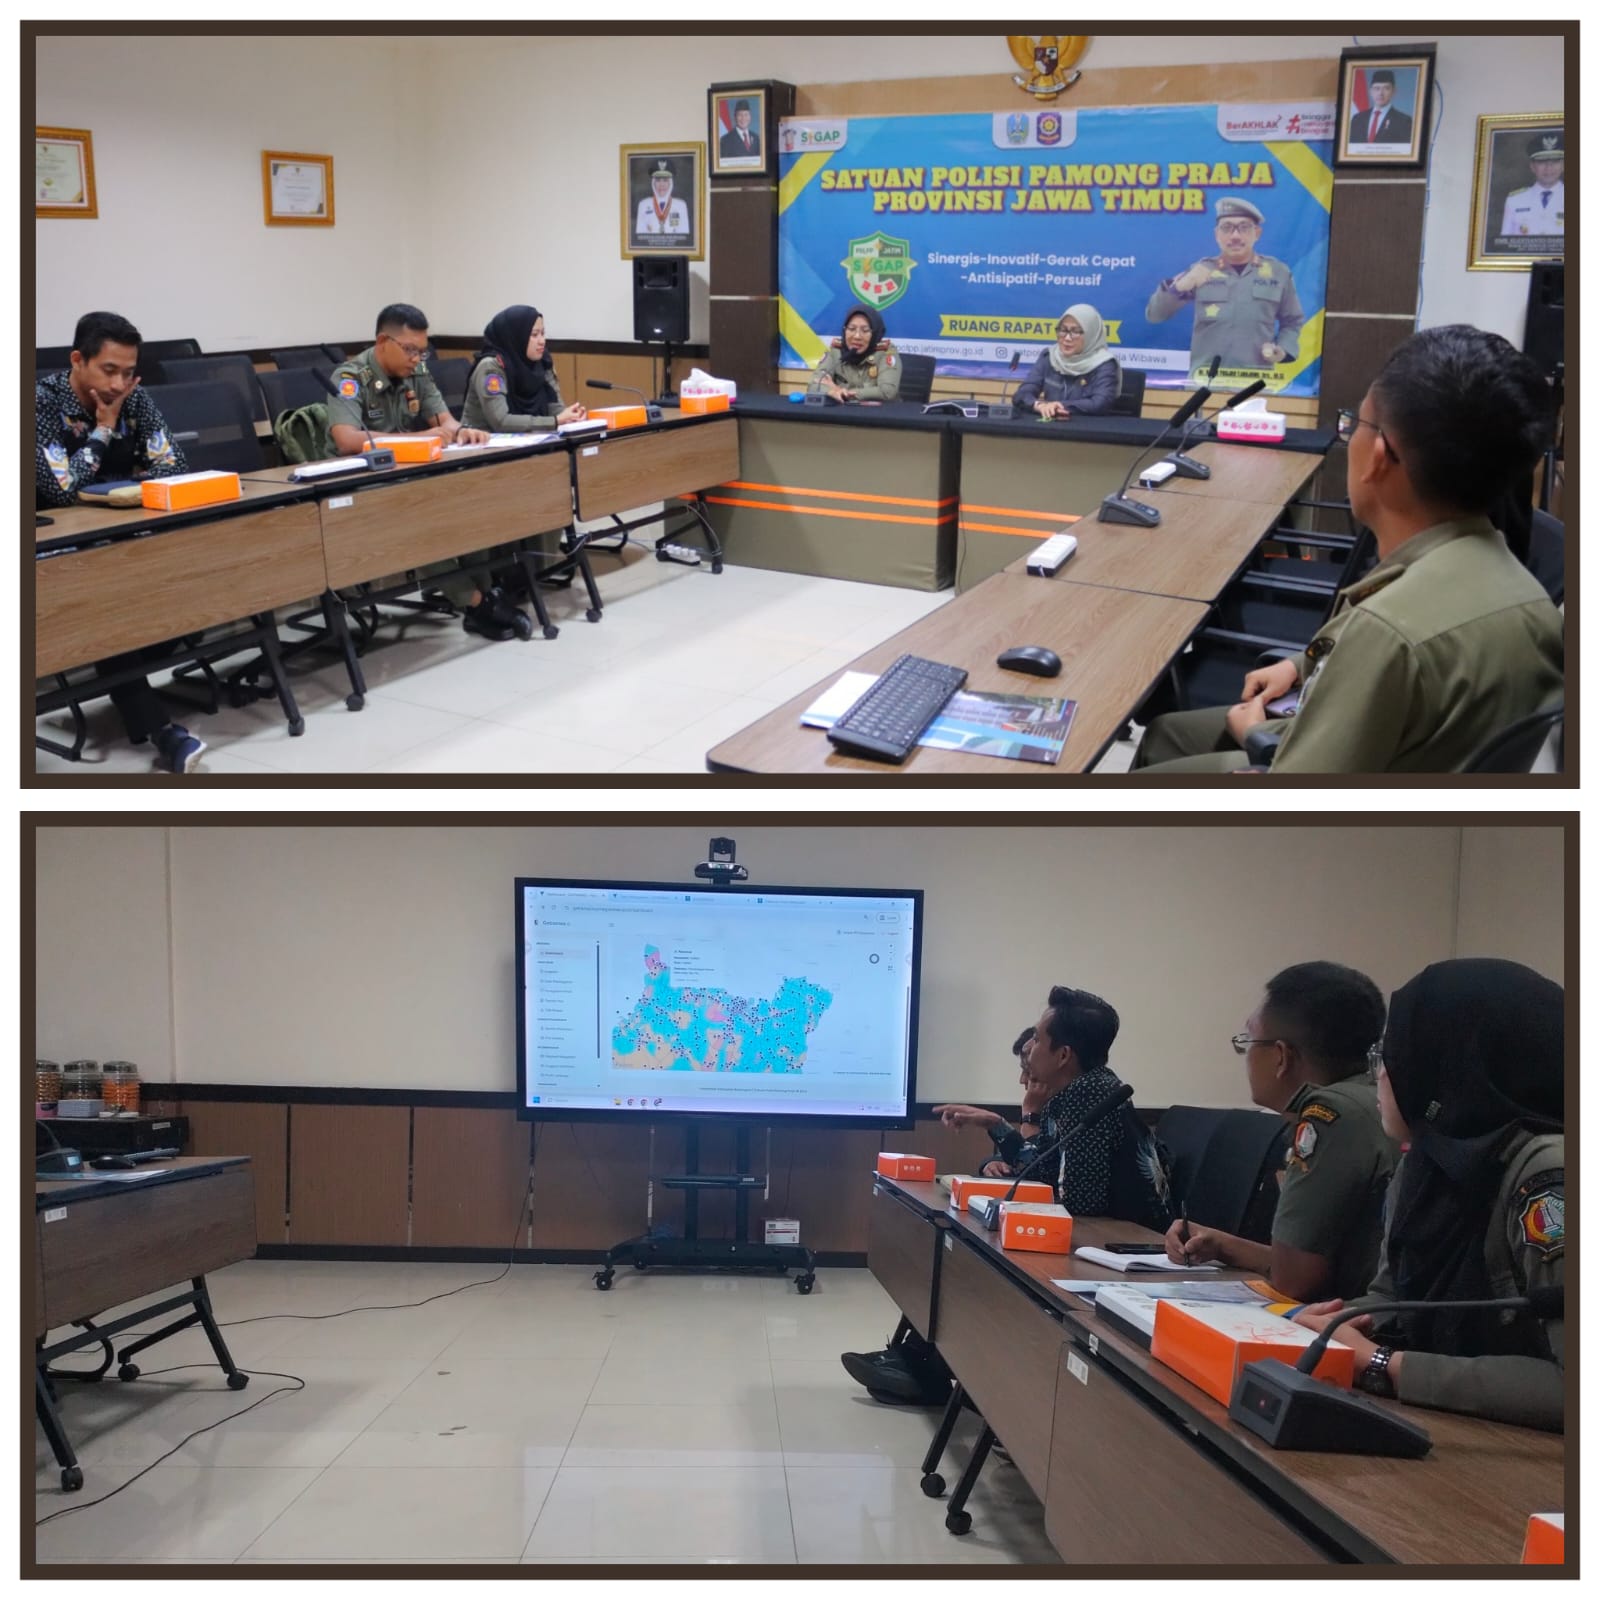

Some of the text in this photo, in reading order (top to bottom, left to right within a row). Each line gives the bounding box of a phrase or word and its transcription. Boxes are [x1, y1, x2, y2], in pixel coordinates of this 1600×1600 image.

[821, 162, 1274, 190] SATUAN POLISI PAMONG PRAJA
[873, 189, 1206, 213] PROVINSI JAWA TIMUR
[927, 252, 1136, 270] Sinergis-Inovatif-Gerak Cepat
[949, 320, 1052, 335] RUANG RAPAT
[1129, 353, 1167, 363] Wibawa
